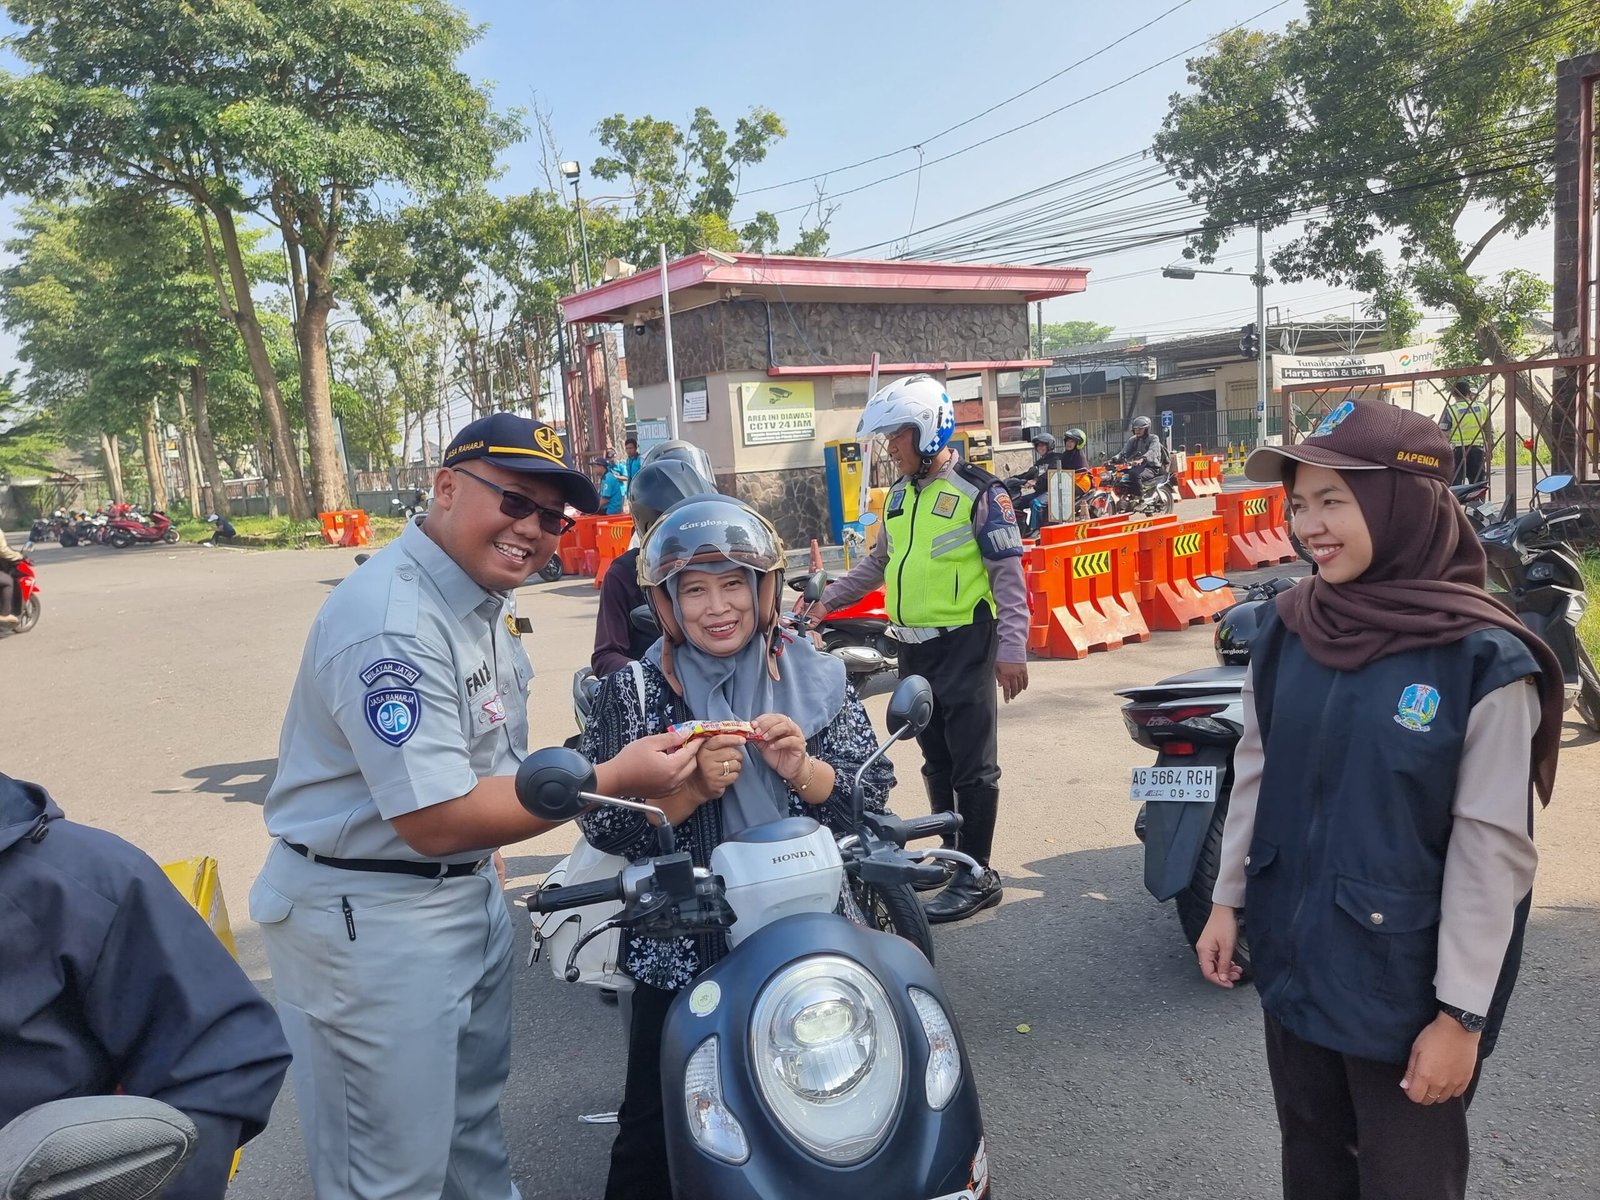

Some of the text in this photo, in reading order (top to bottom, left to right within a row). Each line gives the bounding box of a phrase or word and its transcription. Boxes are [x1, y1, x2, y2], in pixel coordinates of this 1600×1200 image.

[1339, 358, 1366, 367] Zakat
[1412, 352, 1432, 362] bmh
[1284, 367, 1382, 378] Harta Bersih & Berkah
[780, 411, 812, 420] DIAWASI
[749, 419, 812, 431] CCTV 24 JAM
[1396, 451, 1440, 468] BAPENDA
[365, 663, 416, 683] WILAYAH JATIM
[369, 693, 415, 707] JASA RAHARJA
[1132, 769, 1213, 786] AG 5664 RGH
[771, 849, 816, 865] HONDA
